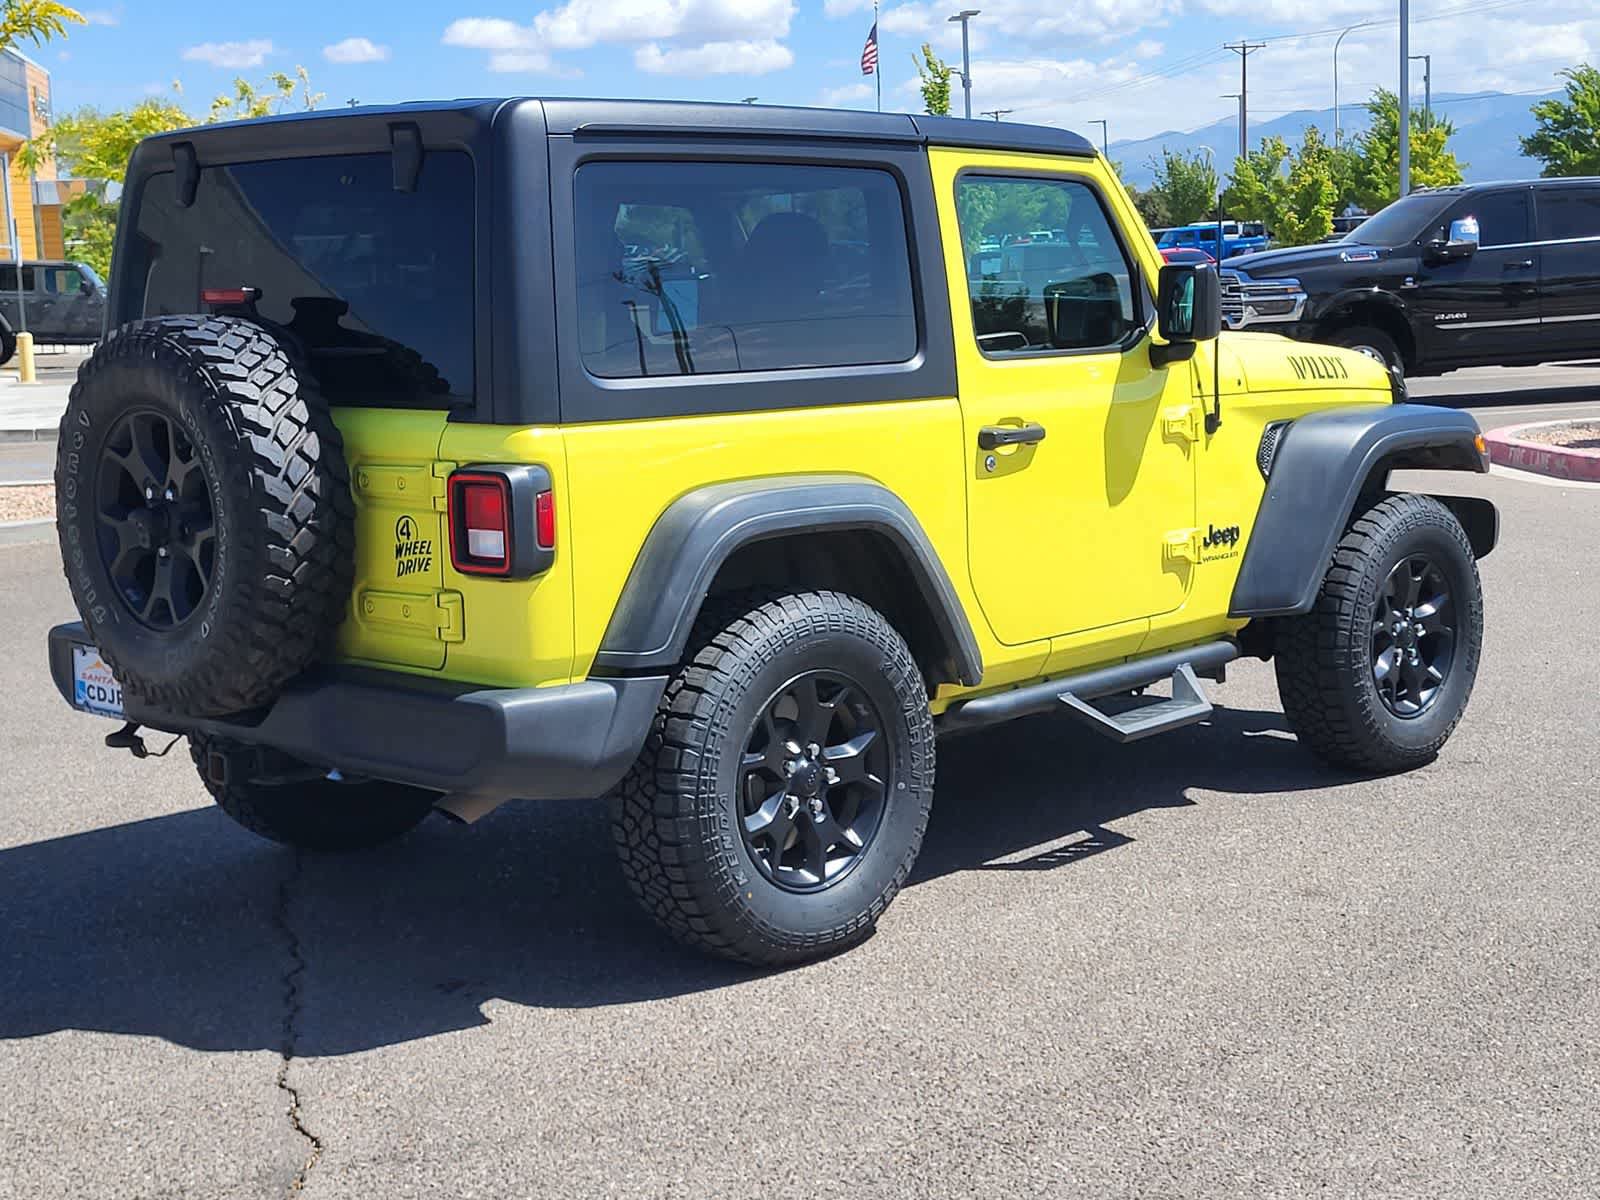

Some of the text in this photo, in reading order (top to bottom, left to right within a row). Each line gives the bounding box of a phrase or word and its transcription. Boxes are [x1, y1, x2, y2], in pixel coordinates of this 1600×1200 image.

[1203, 524, 1240, 550] Jeep
[396, 540, 432, 560] WHEEL
[1202, 551, 1239, 562] WRANGLER
[397, 557, 433, 578] DRIVE
[80, 671, 115, 686] SANTA
[718, 793, 750, 887] KENDA
